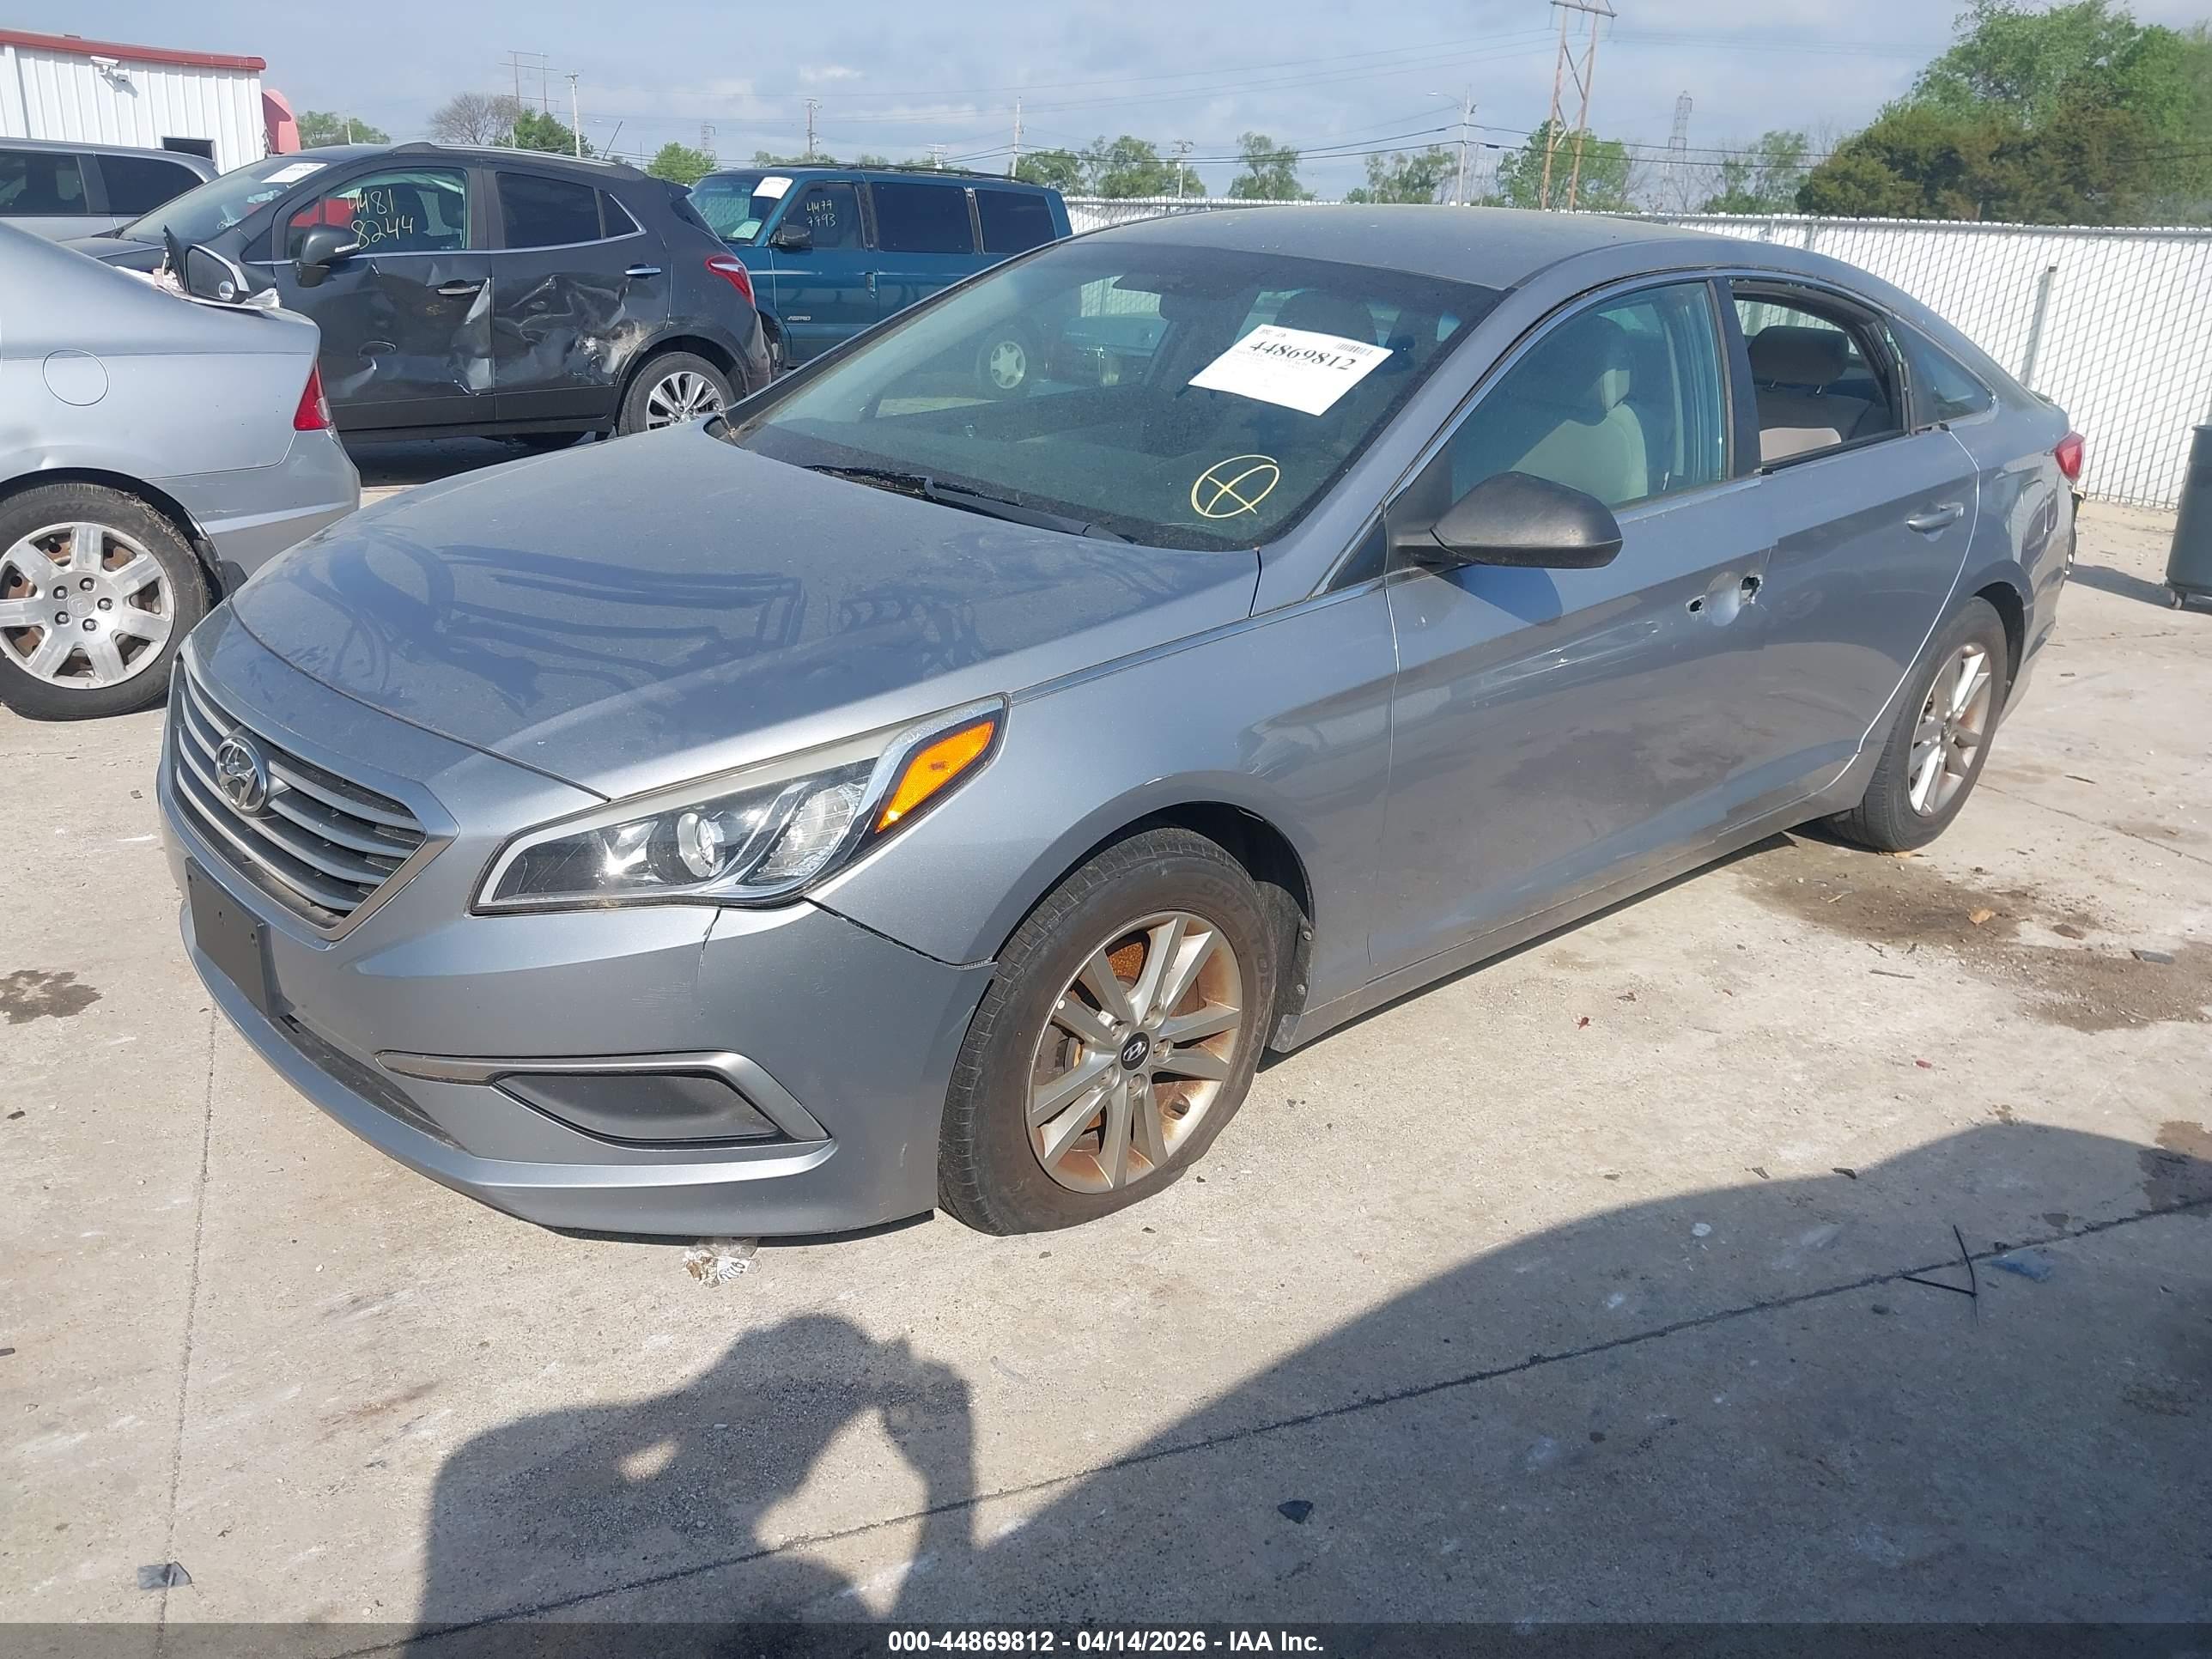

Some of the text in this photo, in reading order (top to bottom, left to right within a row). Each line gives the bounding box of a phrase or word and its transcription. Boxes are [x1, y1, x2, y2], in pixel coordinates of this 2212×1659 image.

[346, 187, 395, 215] 4481
[805, 199, 833, 214] 4477
[350, 215, 414, 250] 8244
[806, 213, 836, 228] 7793
[1249, 340, 1357, 371] 44869812
